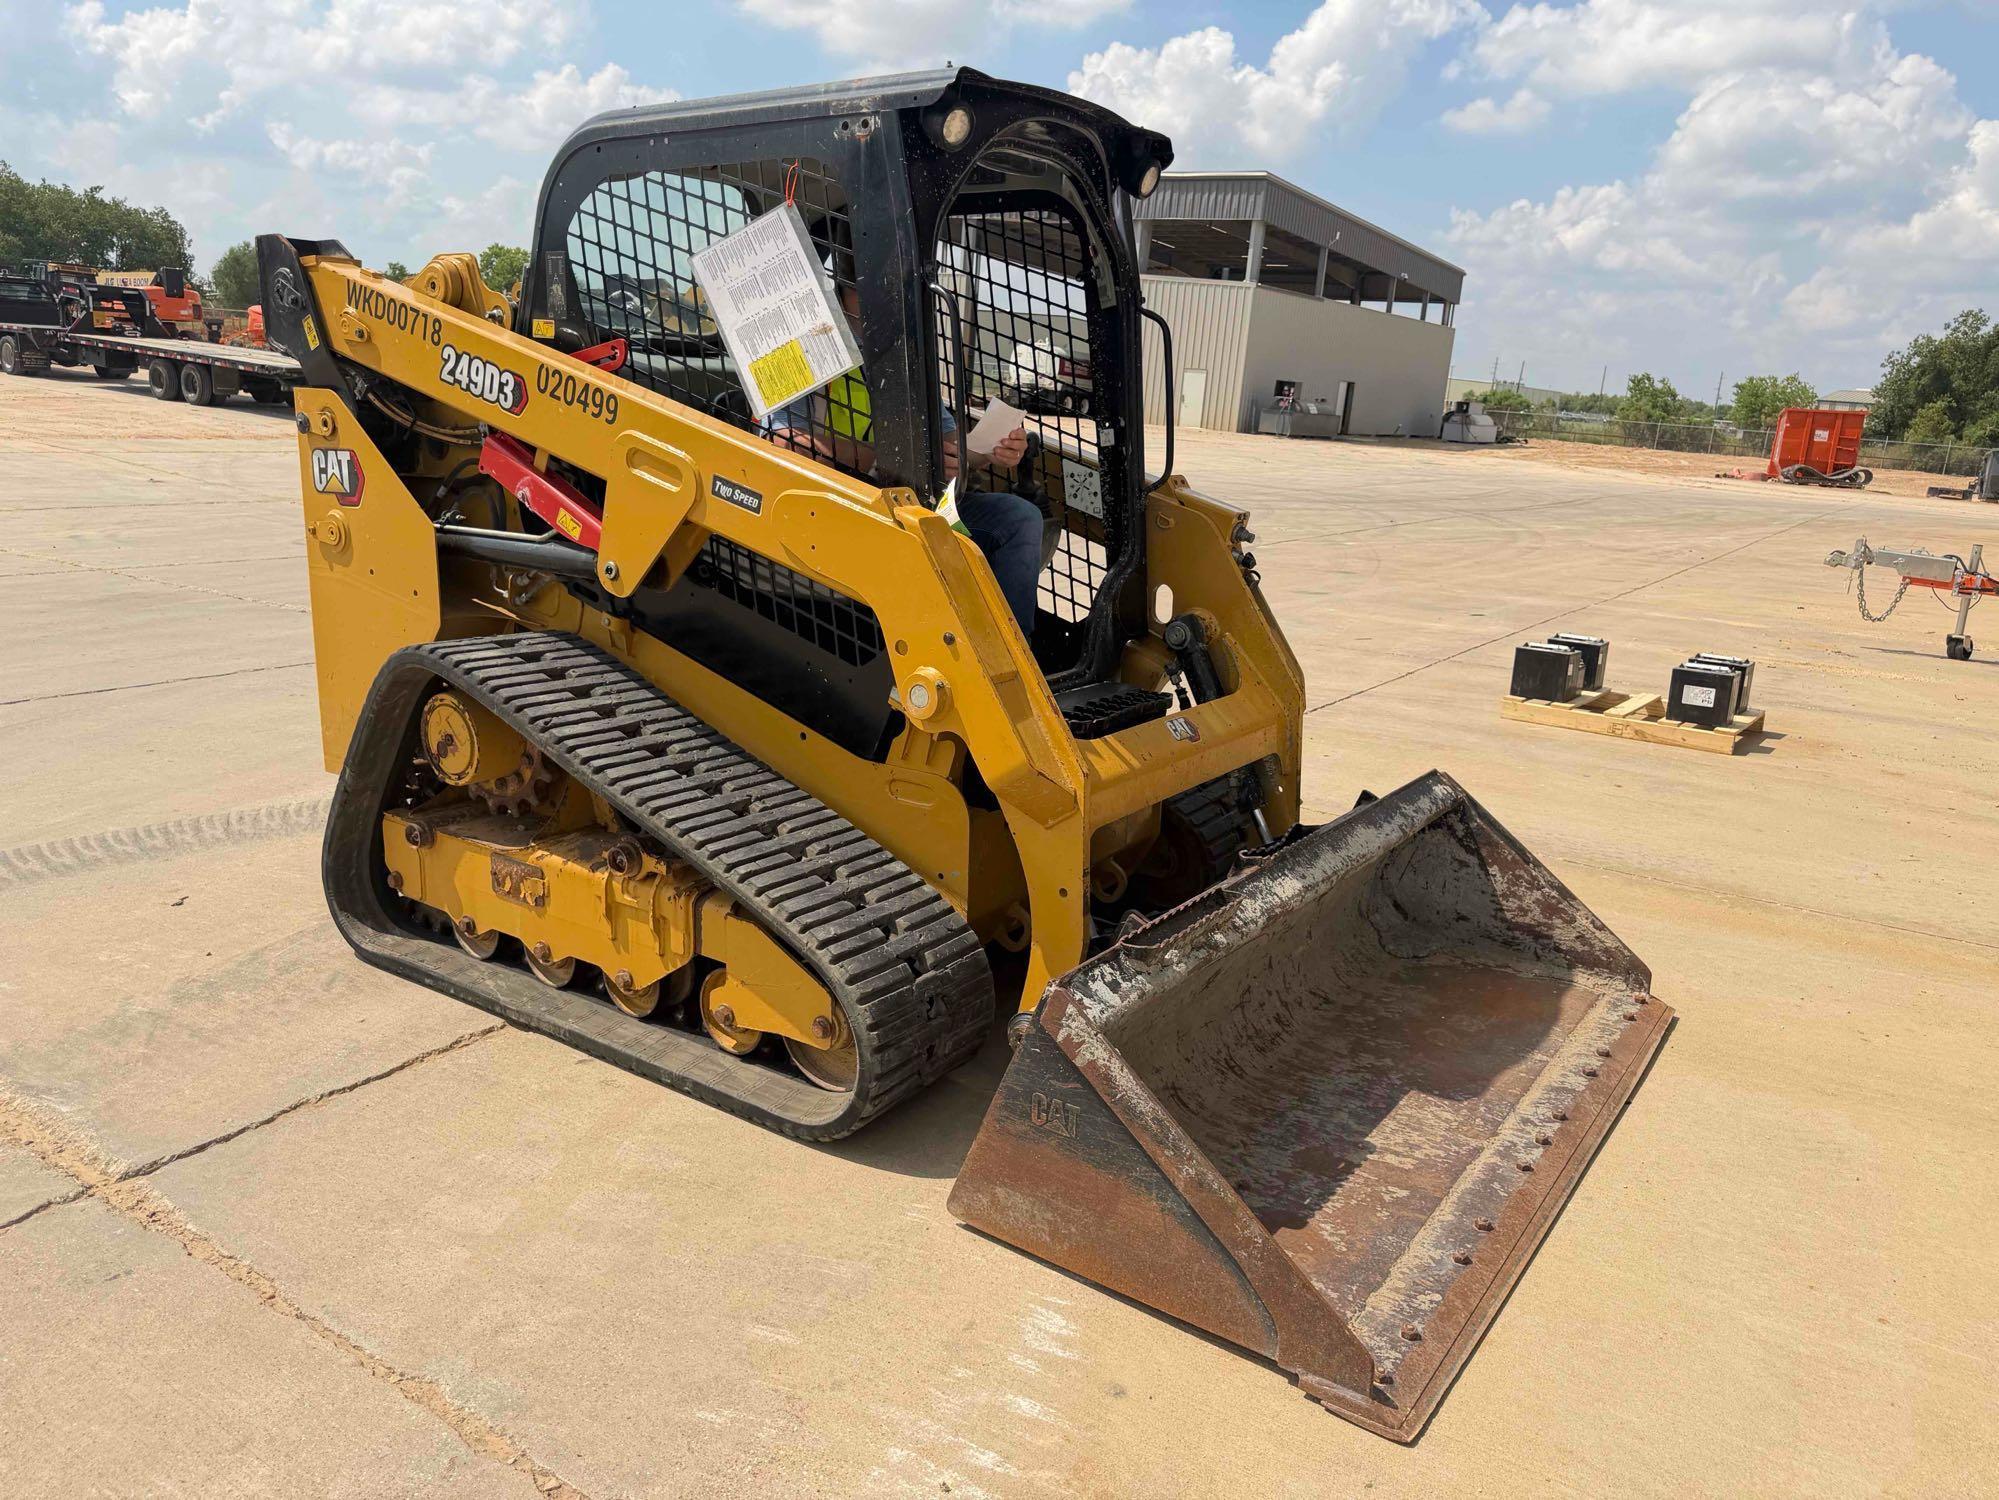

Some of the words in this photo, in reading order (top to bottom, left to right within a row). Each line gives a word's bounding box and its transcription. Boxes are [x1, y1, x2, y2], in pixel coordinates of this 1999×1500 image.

[346, 279, 443, 347] WKD00718
[440, 345, 515, 410] 249D3
[536, 363, 619, 426] 020499
[312, 449, 351, 493] CAT
[714, 480, 733, 499] TWO
[733, 489, 759, 508] SPEED
[1166, 716, 1196, 741] CAT
[1031, 1092, 1081, 1139] CAT
